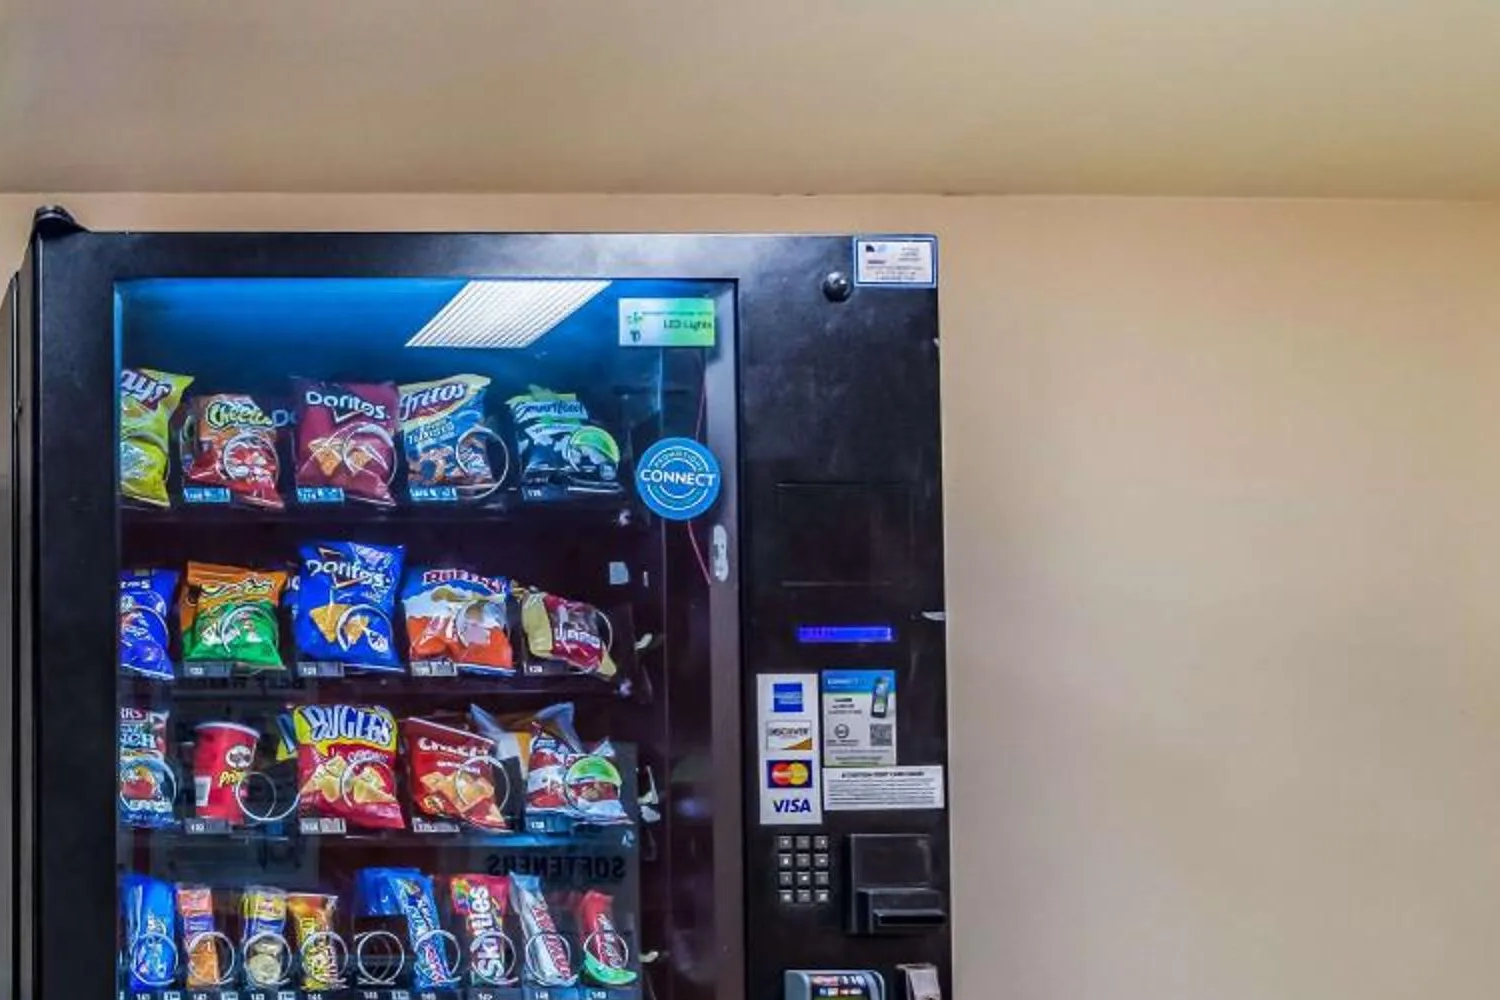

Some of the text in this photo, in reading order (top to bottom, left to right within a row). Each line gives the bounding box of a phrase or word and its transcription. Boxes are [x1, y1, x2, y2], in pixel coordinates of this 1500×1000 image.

[305, 389, 387, 421] Doritos
[641, 469, 717, 487] CONNECT
[306, 558, 387, 588] Doritos
[772, 798, 812, 813] VISA
